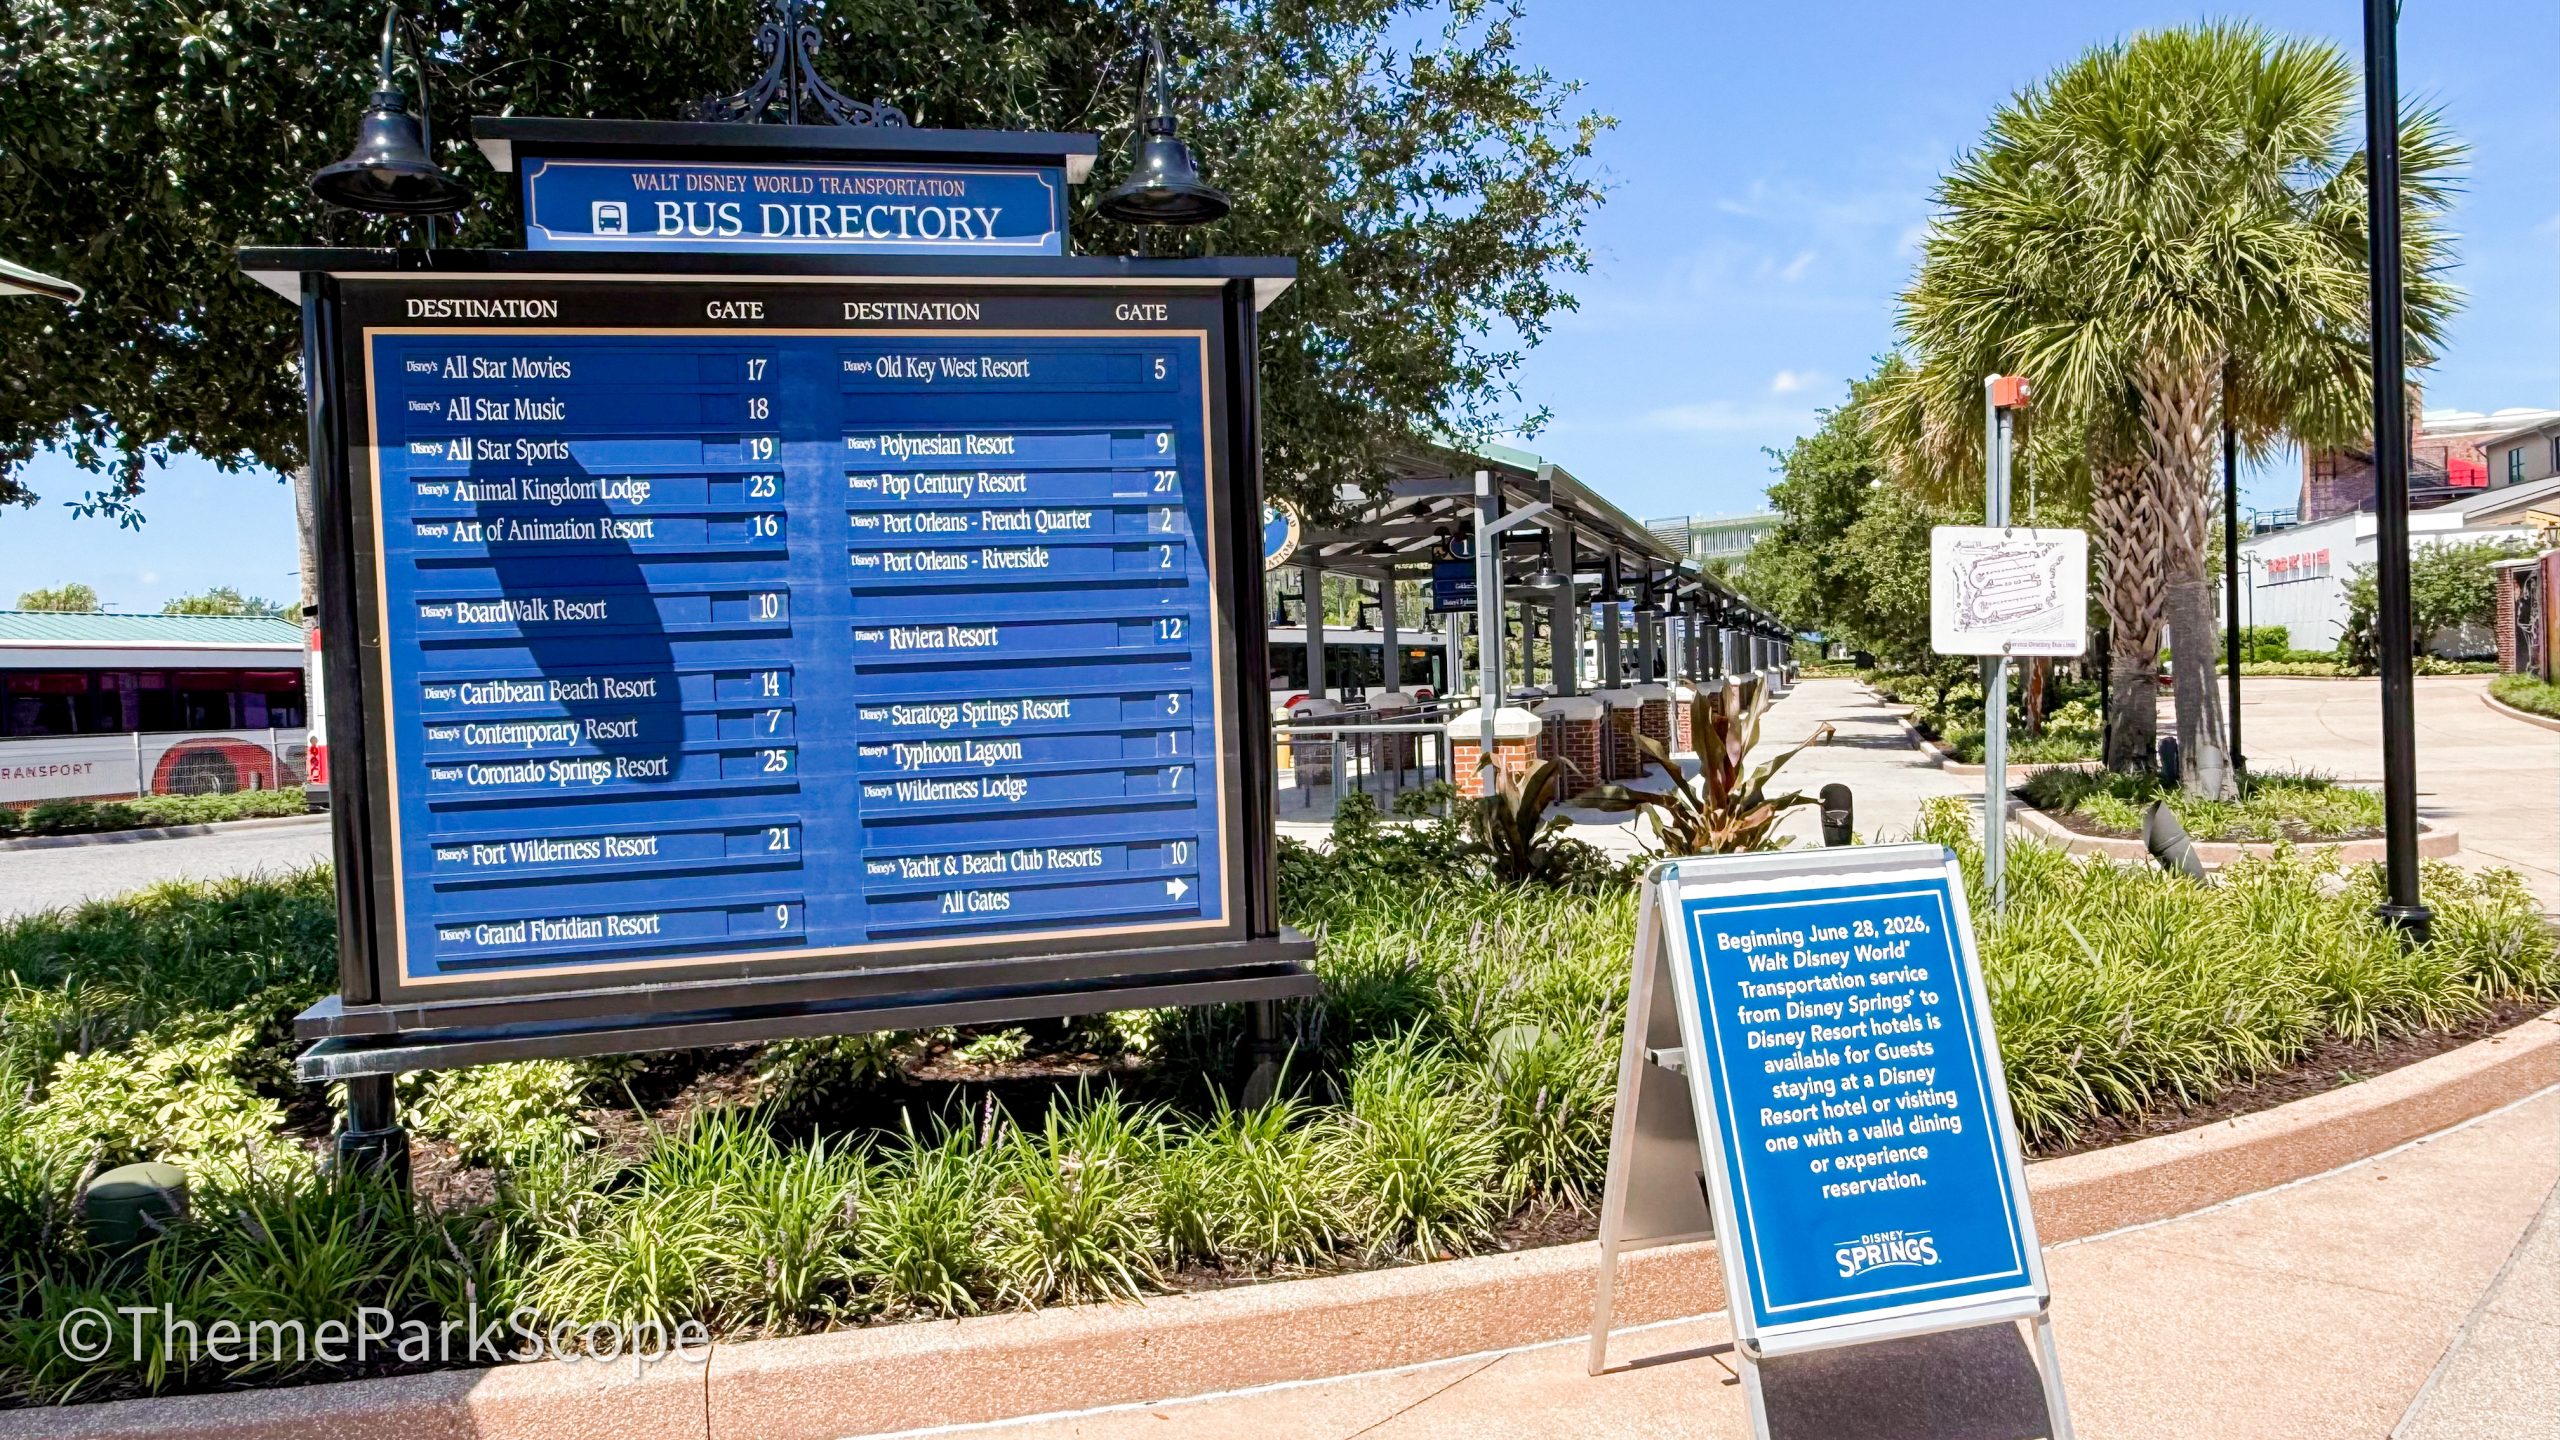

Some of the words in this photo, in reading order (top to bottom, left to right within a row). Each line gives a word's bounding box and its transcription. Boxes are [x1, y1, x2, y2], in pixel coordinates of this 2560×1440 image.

[632, 174, 679, 190] WALT
[687, 175, 746, 192] DISNEY
[754, 176, 813, 193] WORLD
[819, 178, 964, 196] TRANSPORTATION
[656, 202, 742, 237] BUS
[761, 204, 1002, 240] DIRECTORY
[406, 299, 557, 318] DESTINATION
[707, 302, 764, 318] GATE
[844, 303, 979, 320] DESTINATION
[1116, 304, 1167, 320] GATE
[407, 361, 437, 374] Disney's
[443, 356, 468, 378] All
[473, 357, 507, 378] Star
[512, 356, 570, 378] Movies
[748, 359, 767, 380] 17
[844, 361, 872, 373] Disney's
[876, 356, 902, 377] Old
[906, 358, 936, 383] Key
[940, 358, 977, 377] West
[981, 358, 1030, 377] Resort
[1155, 359, 1165, 379] 5
[409, 401, 440, 413] Disney's
[447, 397, 472, 420] All
[476, 399, 509, 420] Star
[515, 397, 565, 420] Music
[749, 398, 768, 419] 18
[411, 443, 443, 456] Disney's
[447, 438, 472, 460] All
[478, 439, 511, 460] Star
[516, 439, 568, 465] Sports
[751, 438, 772, 459] 19
[848, 438, 876, 451] Disney's
[881, 434, 962, 461] Polynesian
[966, 435, 1015, 454] Resort
[1157, 433, 1168, 453] 9
[418, 483, 449, 497] Disney's
[454, 478, 517, 501] Animal
[522, 477, 597, 505] Kingdom
[601, 477, 650, 505] Lodge
[751, 476, 775, 497] 23
[849, 477, 878, 489] Disney's
[881, 474, 910, 500] Pop
[914, 474, 974, 498] Century
[978, 473, 1027, 492] Resort
[1154, 471, 1176, 491] 27
[417, 525, 448, 537] Disney's
[453, 521, 482, 542] Art
[487, 518, 504, 541] of
[508, 518, 595, 540] Animation
[600, 518, 654, 538] Resort
[754, 515, 777, 536] 16
[851, 516, 879, 528] Disney's
[883, 514, 912, 532] Port
[915, 512, 968, 532] Orleans
[982, 509, 1031, 530] French
[1035, 510, 1092, 533] Quarter
[1162, 508, 1173, 533] 2
[851, 555, 879, 567] Disney's
[883, 553, 912, 571] Port
[915, 551, 968, 570] Orleans
[982, 546, 1048, 569] Riverside
[1161, 545, 1171, 568] 2
[1462, 539, 1469, 555] 1
[421, 606, 452, 619] Disney's
[456, 598, 549, 623] BoardWalk
[553, 600, 607, 620] Resort
[760, 594, 778, 618] 10
[855, 631, 884, 642] Disney's
[890, 627, 944, 649] Riviera
[948, 627, 998, 647] Resort
[1160, 618, 1181, 639] 12
[425, 688, 456, 700] Disney's
[461, 681, 545, 704] Caribbean
[549, 677, 598, 701] Beach
[603, 678, 656, 698] Resort
[762, 672, 779, 696] 14
[860, 709, 888, 721] Disney's
[892, 705, 958, 729] Saratoga
[962, 701, 1018, 728] Springs
[1022, 699, 1070, 719] Resort
[1168, 694, 1179, 714] 3
[429, 728, 459, 741] Disney's
[464, 723, 579, 749] Contemporary
[585, 719, 638, 739] Resort
[767, 709, 781, 732] 7
[892, 741, 962, 770] Typhoon
[965, 741, 1022, 767] Lagoon
[1170, 732, 1177, 754] 1
[431, 768, 463, 781] Disney's
[467, 760, 545, 785] Coronado
[549, 758, 611, 787] Springs
[616, 757, 668, 778] Resort
[764, 750, 787, 771] 25
[864, 786, 892, 798] Disney's
[896, 779, 978, 801] Wilderness
[983, 775, 1027, 801] Lodge
[1169, 766, 1182, 788] 7
[437, 849, 468, 861] Disney's
[472, 845, 507, 865] Fort
[510, 839, 600, 862] Wilderness
[605, 836, 658, 857] Resort
[769, 828, 790, 850] 21
[868, 863, 896, 875] Disney's
[898, 856, 940, 878] Yacht
[944, 856, 959, 875] &
[962, 851, 1007, 874] Beach
[1011, 849, 1043, 871] Club
[1047, 848, 1102, 868] Resorts
[1171, 842, 1187, 864] 10
[942, 891, 964, 913] All
[968, 891, 1010, 911] Gates
[440, 928, 471, 942] Disney's
[475, 921, 526, 945] Grand
[530, 917, 602, 941] Floridian
[607, 914, 660, 936] Resort
[777, 905, 788, 929] 9
[1718, 928, 1804, 953] Beginning
[1809, 925, 1848, 942] June
[1853, 920, 1879, 938] 28,
[1884, 916, 1930, 934] 2026,
[1748, 952, 1788, 972] Walt
[1794, 950, 1849, 968] Disney
[1738, 974, 1865, 1000] Transportation
[1870, 965, 1928, 985] service
[1738, 1006, 1780, 1024] from
[1787, 1001, 1843, 1019] Disney
[1919, 990, 1939, 1005] to
[1748, 1030, 1805, 1049] Disney
[1811, 1022, 1867, 1042] Resort
[1870, 1014, 1923, 1035] hotels
[1926, 1013, 1941, 1029] is
[1765, 1048, 1840, 1073] available
[1844, 1045, 1870, 1064] for
[1875, 1041, 1934, 1060] Guests
[1773, 1077, 1836, 1100] staying
[1841, 1074, 1859, 1090] at
[1864, 1075, 1874, 1088] a
[1880, 1067, 1935, 1086] Disney
[1761, 1104, 1818, 1126] Resort
[1822, 1096, 1867, 1118] hotel
[1872, 1099, 1890, 1112] or
[1896, 1088, 1958, 1109] visiting
[1766, 1136, 1798, 1152] one
[1803, 1126, 1842, 1147] with
[1848, 1129, 1858, 1142] a
[1862, 1117, 1904, 1139] valid
[1909, 1113, 1962, 1134] dining
[1811, 1158, 1829, 1173] or
[1835, 1144, 1928, 1171] experience
[1823, 1172, 1926, 1198] reservation.
[1862, 1230, 1903, 1244] DISNEY
[1836, 1237, 1938, 1278] SPRINGS
